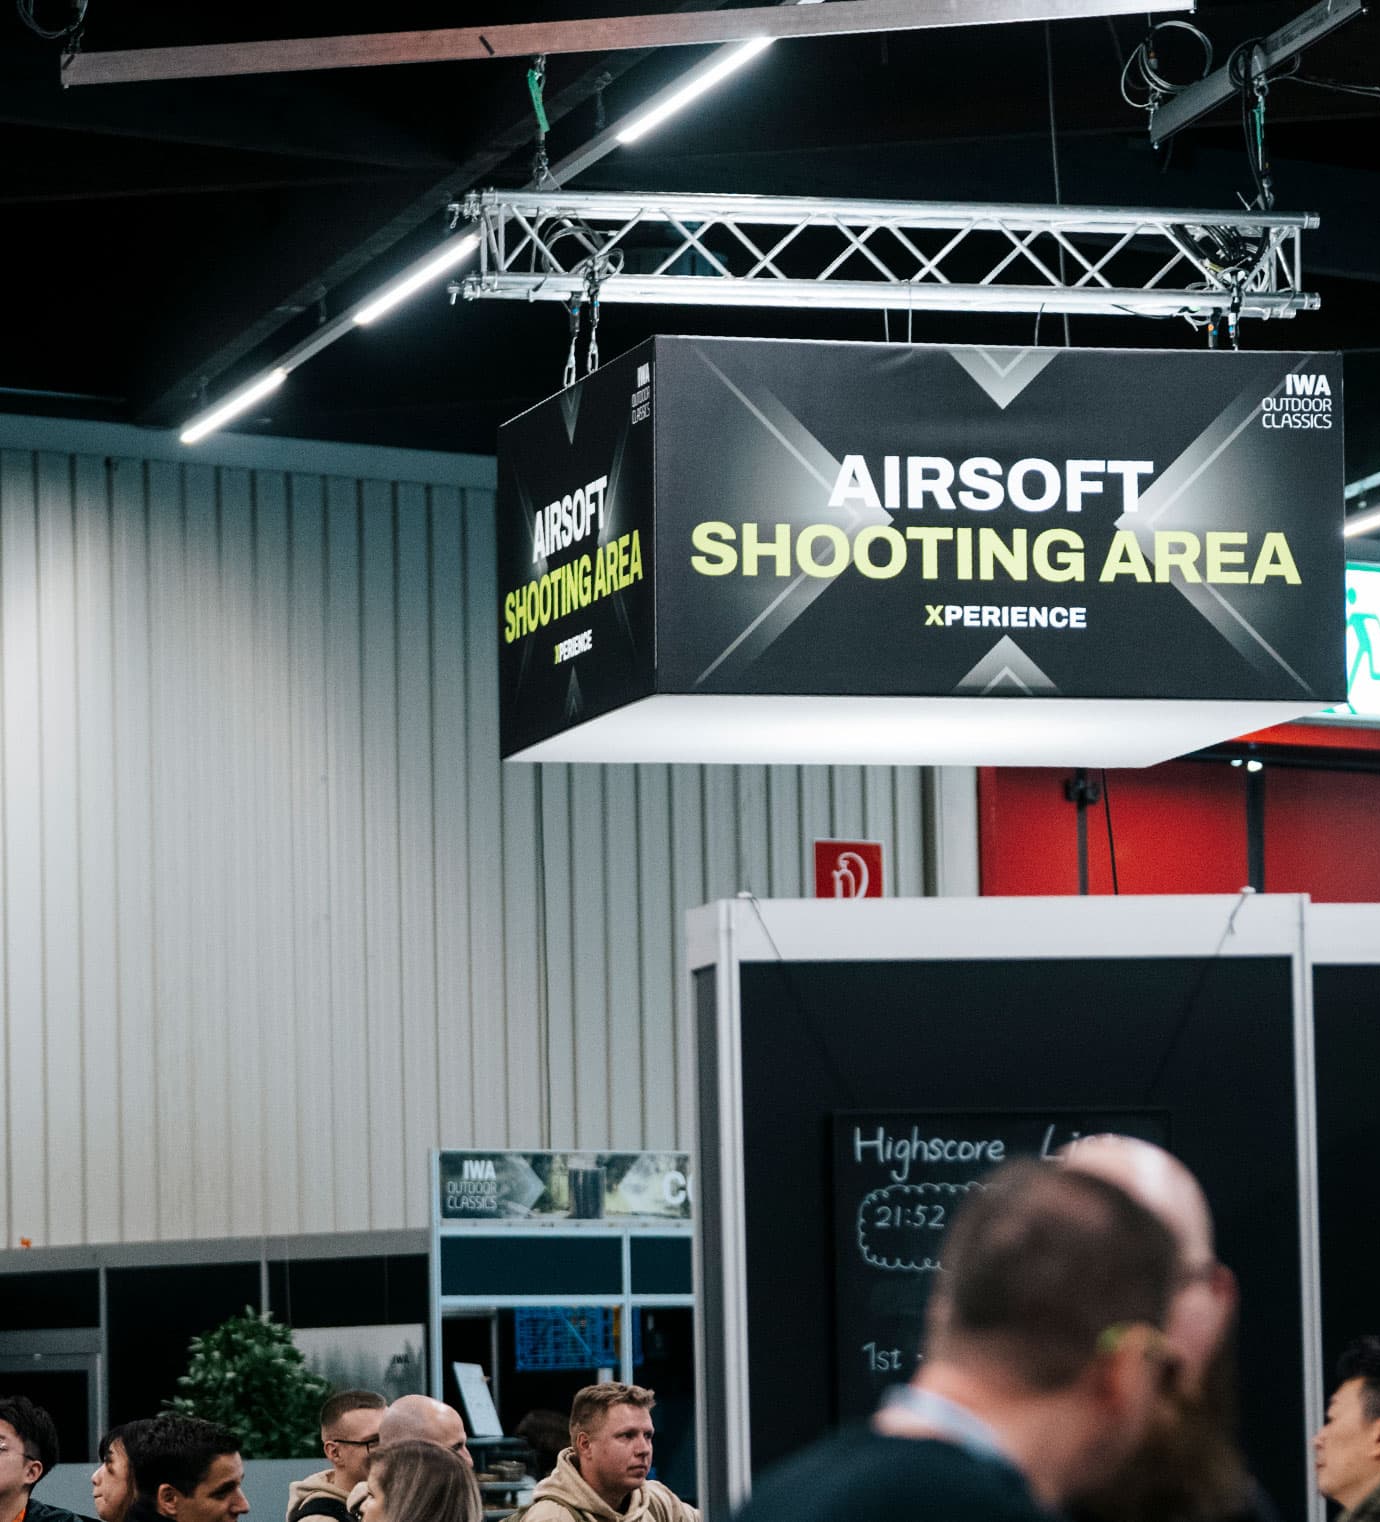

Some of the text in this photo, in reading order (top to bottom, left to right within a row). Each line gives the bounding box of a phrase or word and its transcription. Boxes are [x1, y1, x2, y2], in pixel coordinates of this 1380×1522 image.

[1286, 374, 1332, 396] IWA
[1262, 397, 1332, 412] OUTDOOR
[1262, 413, 1332, 429] CLASSICS
[827, 454, 1154, 513] AIRSOFT
[532, 475, 608, 564] AIRSOFT
[691, 521, 1303, 585] SHOOTING AREA
[505, 529, 644, 645] SHOOTING AREA
[925, 605, 1087, 629] XPERIENCE
[554, 629, 593, 665] XPERIENCE
[854, 1124, 1006, 1182] Highscore
[463, 1160, 497, 1180] IWA
[447, 1181, 497, 1194] OUTDOOR
[447, 1195, 497, 1210] CLASSICS
[874, 1204, 946, 1229] 21:52
[862, 1341, 903, 1372] 1st
